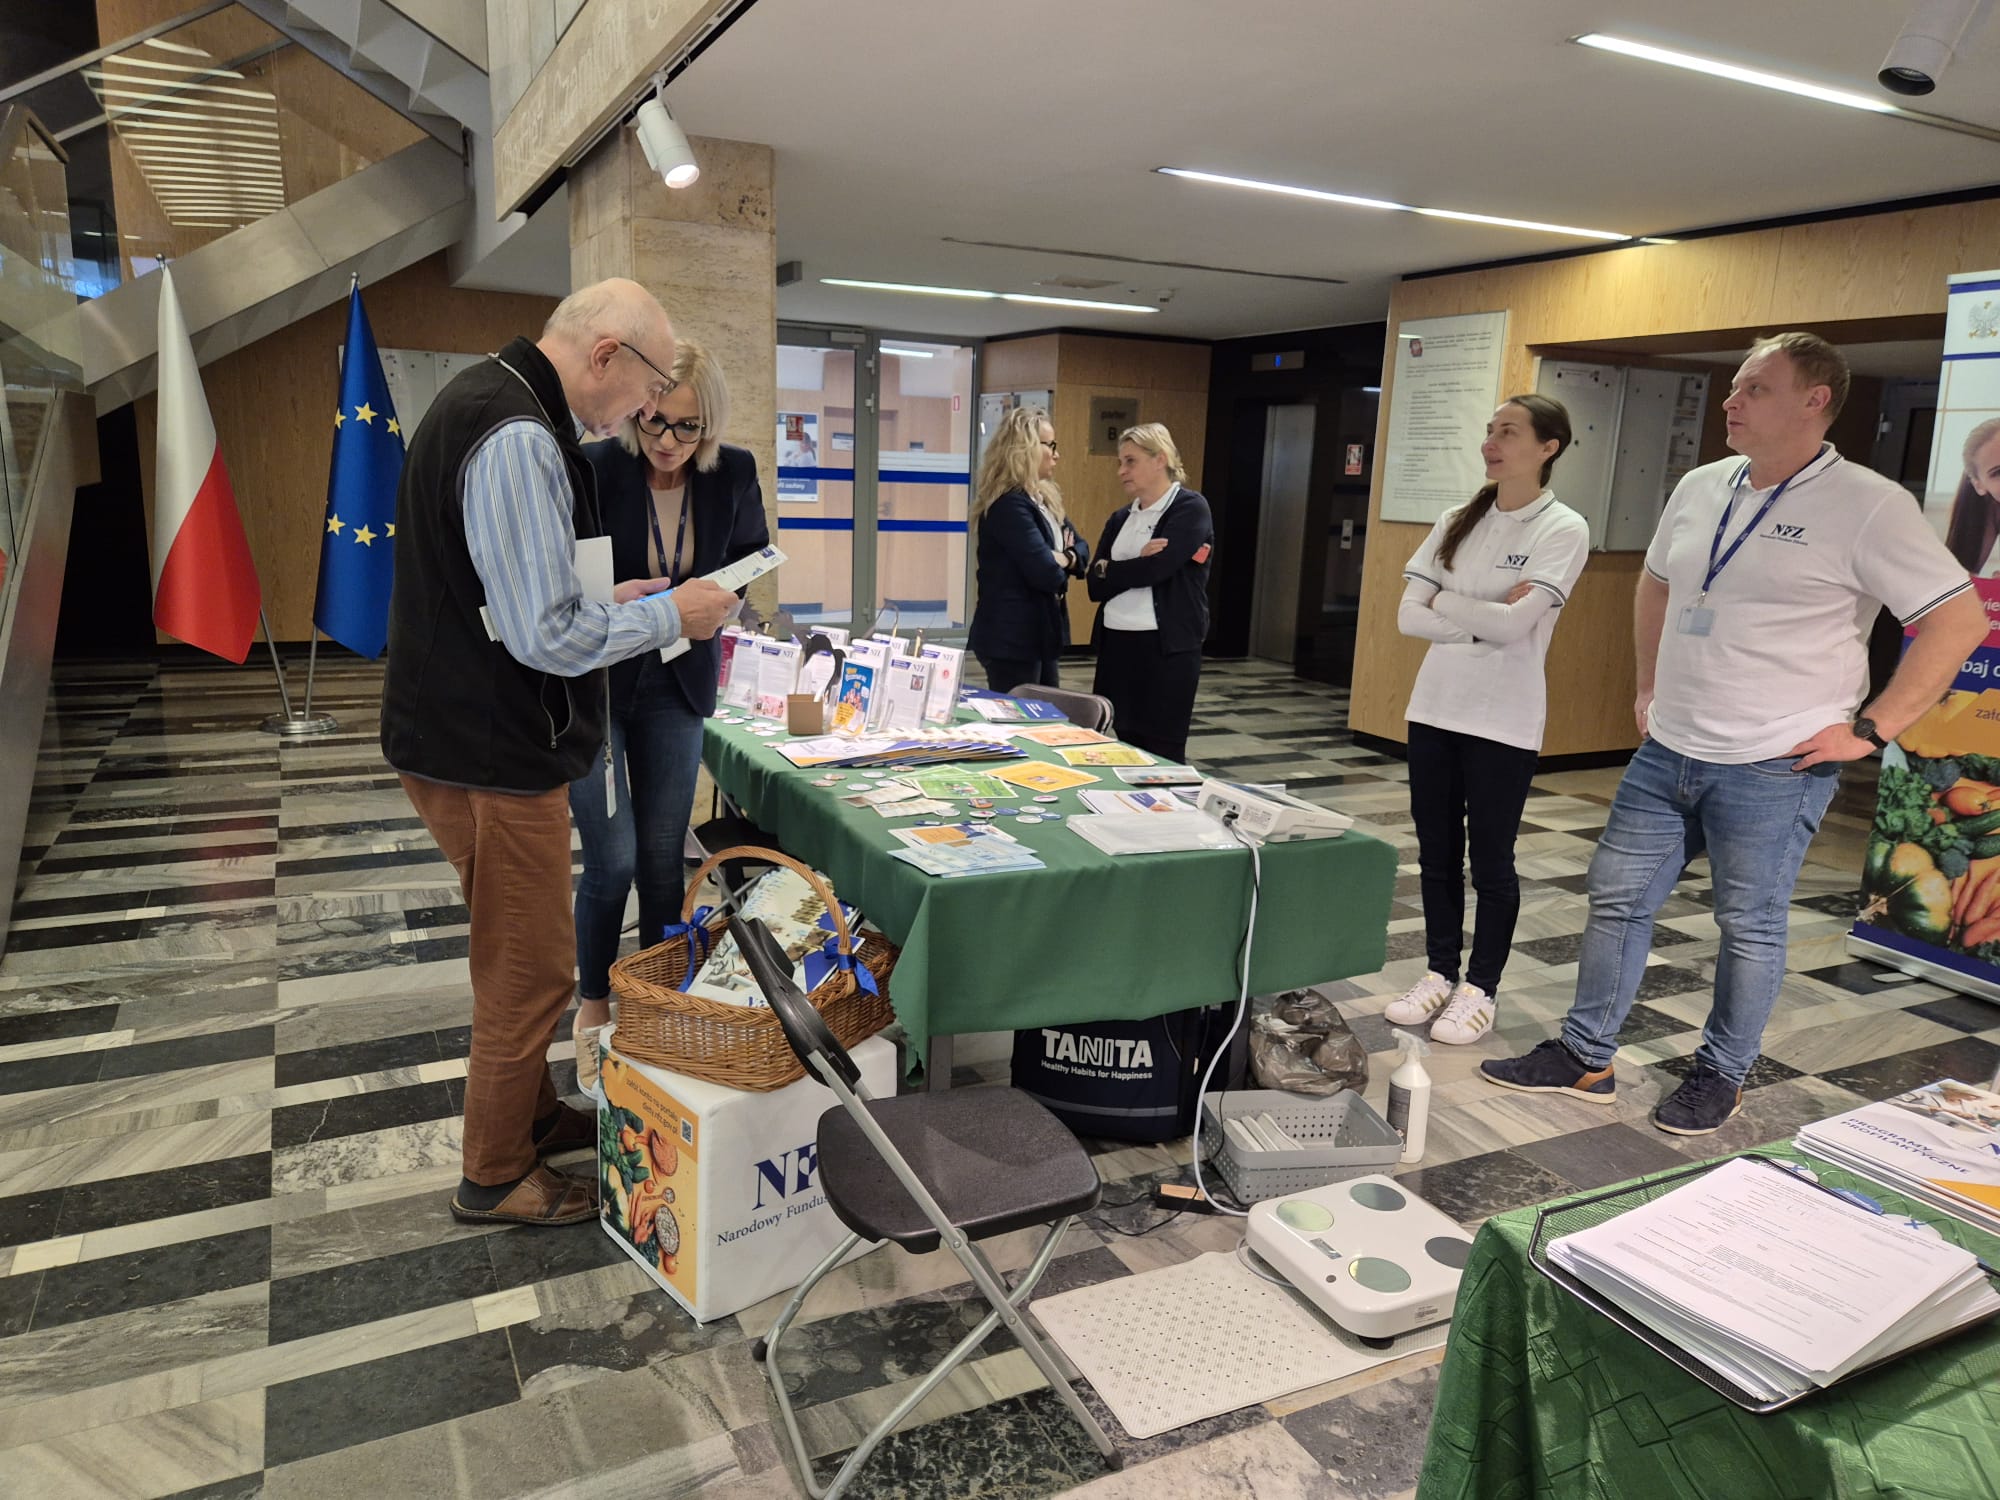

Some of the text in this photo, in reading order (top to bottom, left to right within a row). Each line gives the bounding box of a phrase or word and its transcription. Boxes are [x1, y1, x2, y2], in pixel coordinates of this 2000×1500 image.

[1108, 427, 1117, 440] B
[1770, 523, 1806, 539] NFZ
[1042, 1028, 1153, 1068] TANITA
[1041, 1060, 1152, 1080] Healthy Habits for Happiness
[1840, 1121, 1971, 1175] PROFILAKTYCZNE
[1848, 1118, 1933, 1151] PROGRAMY
[717, 1213, 782, 1246] Narodowy
